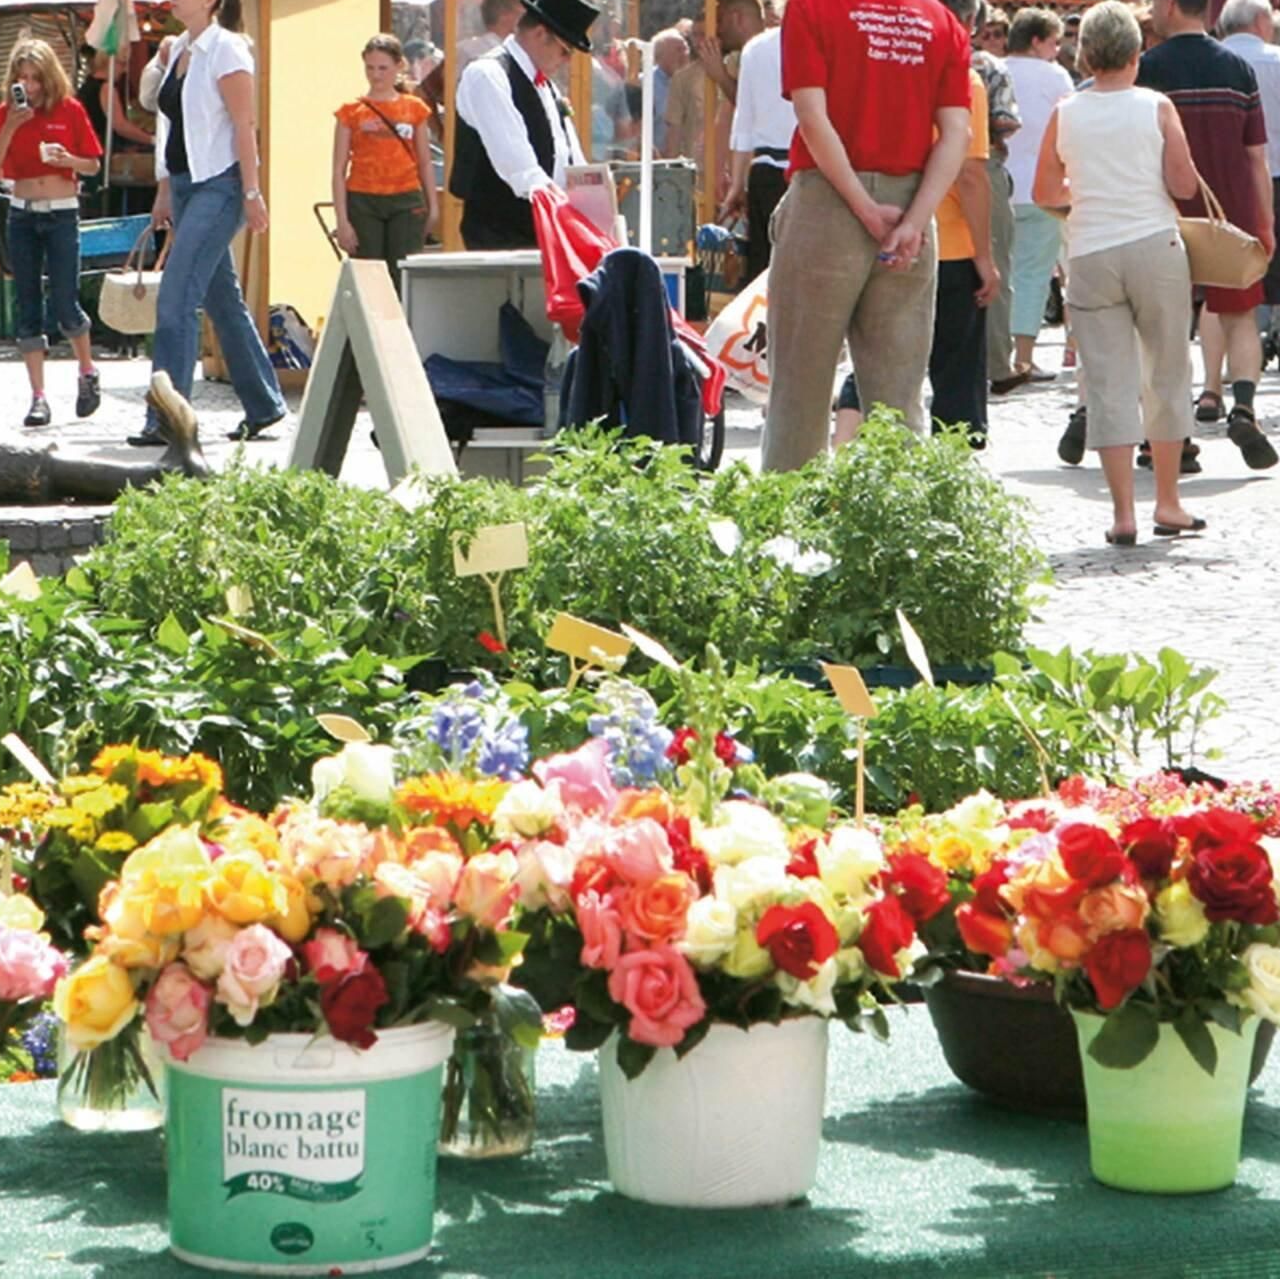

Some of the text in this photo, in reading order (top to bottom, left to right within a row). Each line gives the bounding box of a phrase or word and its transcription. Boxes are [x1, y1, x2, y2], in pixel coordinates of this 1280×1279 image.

[227, 1098, 362, 1137] fromage
[226, 1132, 360, 1160] blanc battu
[246, 1173, 285, 1193] 40%
